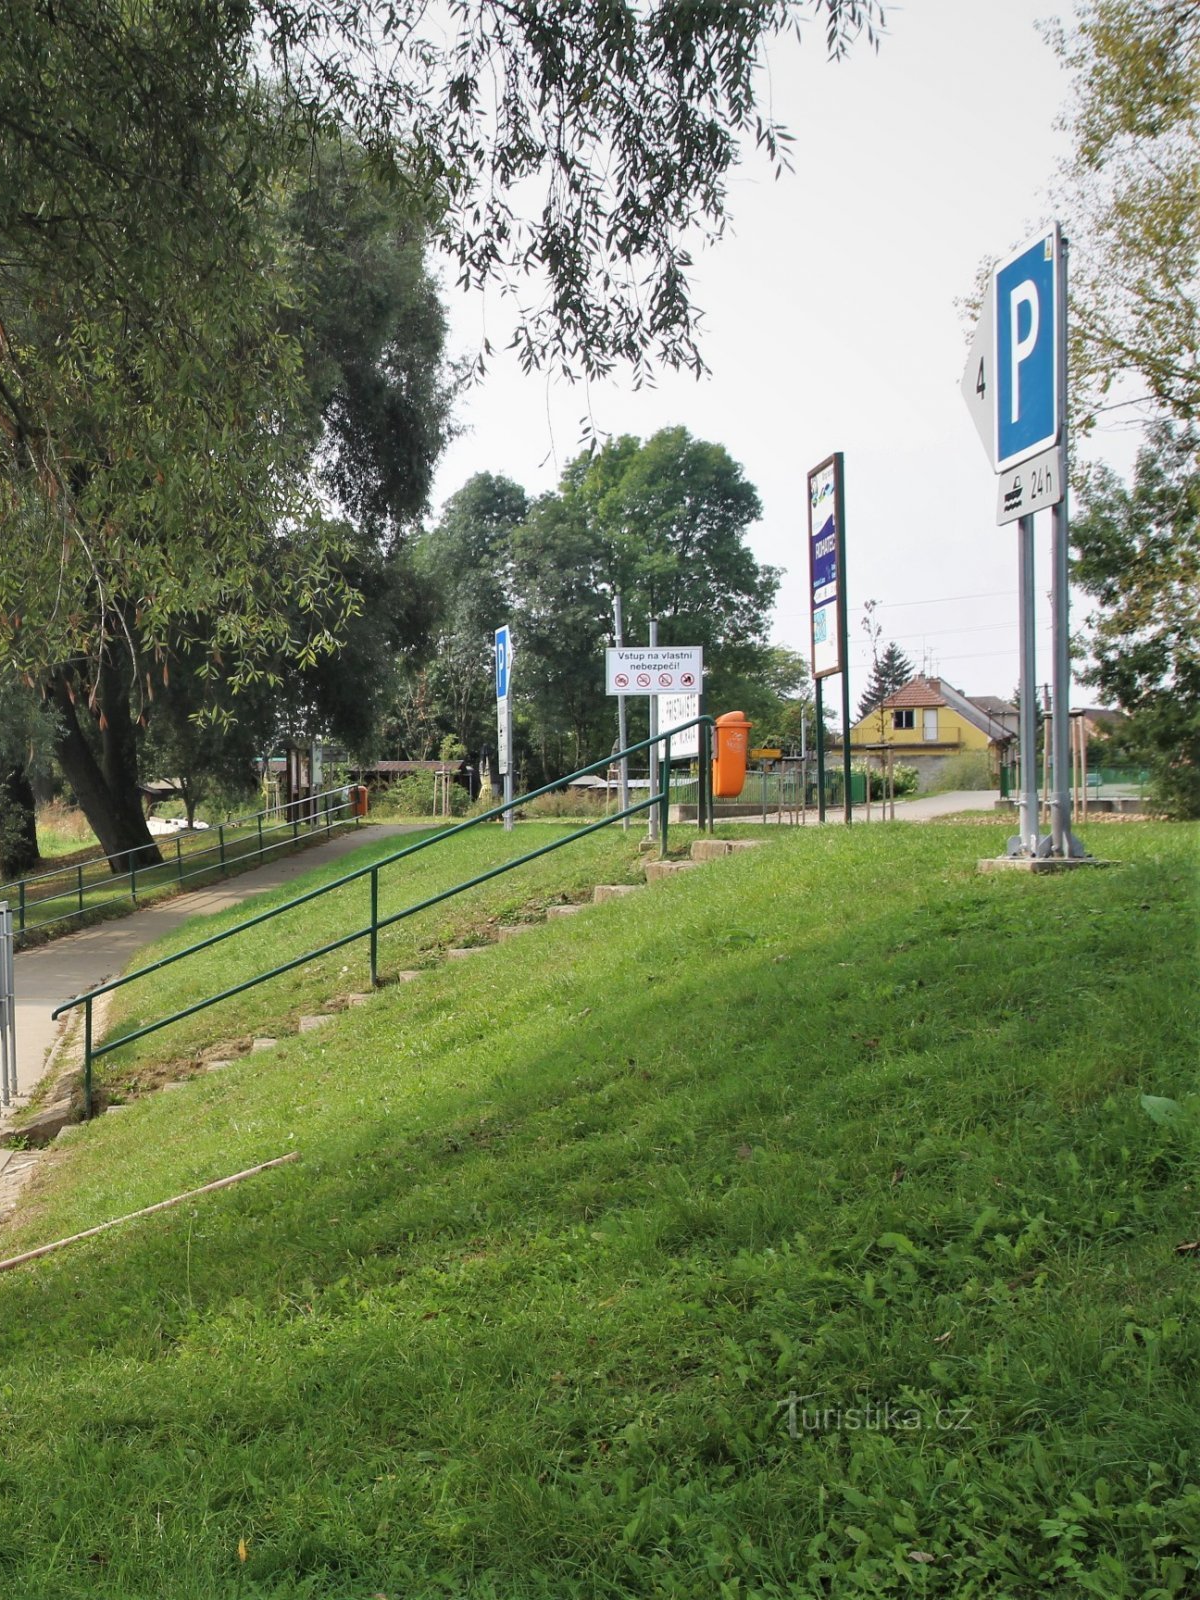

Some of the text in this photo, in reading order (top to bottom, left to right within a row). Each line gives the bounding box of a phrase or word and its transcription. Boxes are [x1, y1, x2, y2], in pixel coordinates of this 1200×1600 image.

[1010, 278, 1040, 424] P
[976, 355, 986, 400] 4
[1031, 468, 1043, 499] 24
[498, 643, 504, 688] P
[618, 652, 645, 661] Vstup
[662, 651, 693, 660] vlastní
[630, 662, 680, 671] nebezpečí!
